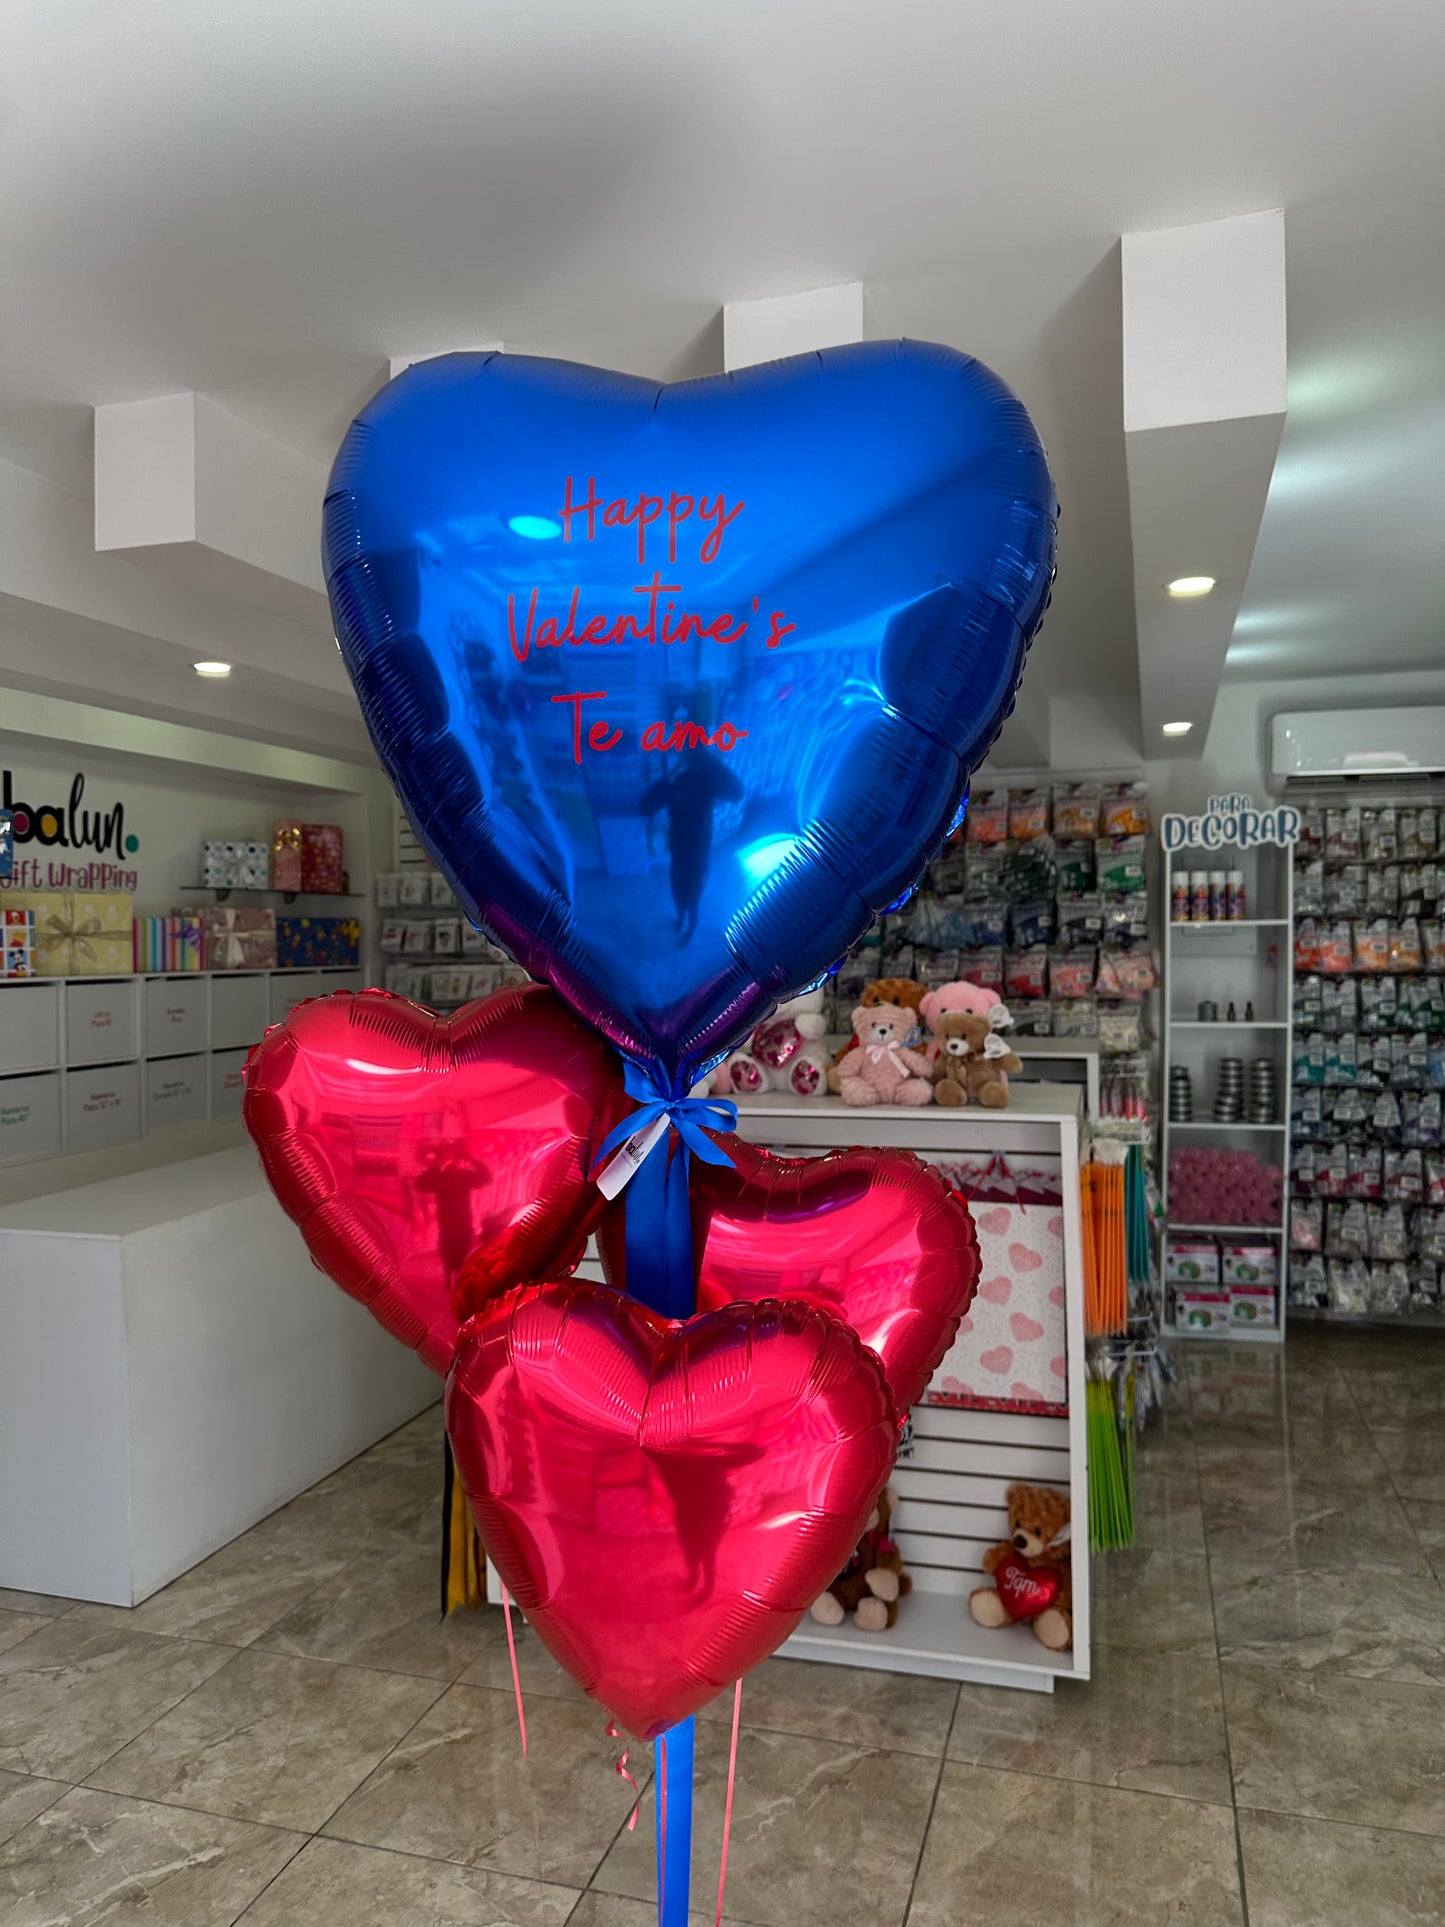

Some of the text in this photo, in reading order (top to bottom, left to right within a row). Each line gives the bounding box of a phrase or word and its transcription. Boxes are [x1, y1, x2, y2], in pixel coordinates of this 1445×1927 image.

[558, 476, 745, 564] Happy
[508, 570, 797, 662] Valentine's
[551, 691, 749, 764] Te amo
[1164, 809, 1298, 849] DECORAR
[1210, 796, 1250, 813] PARA
